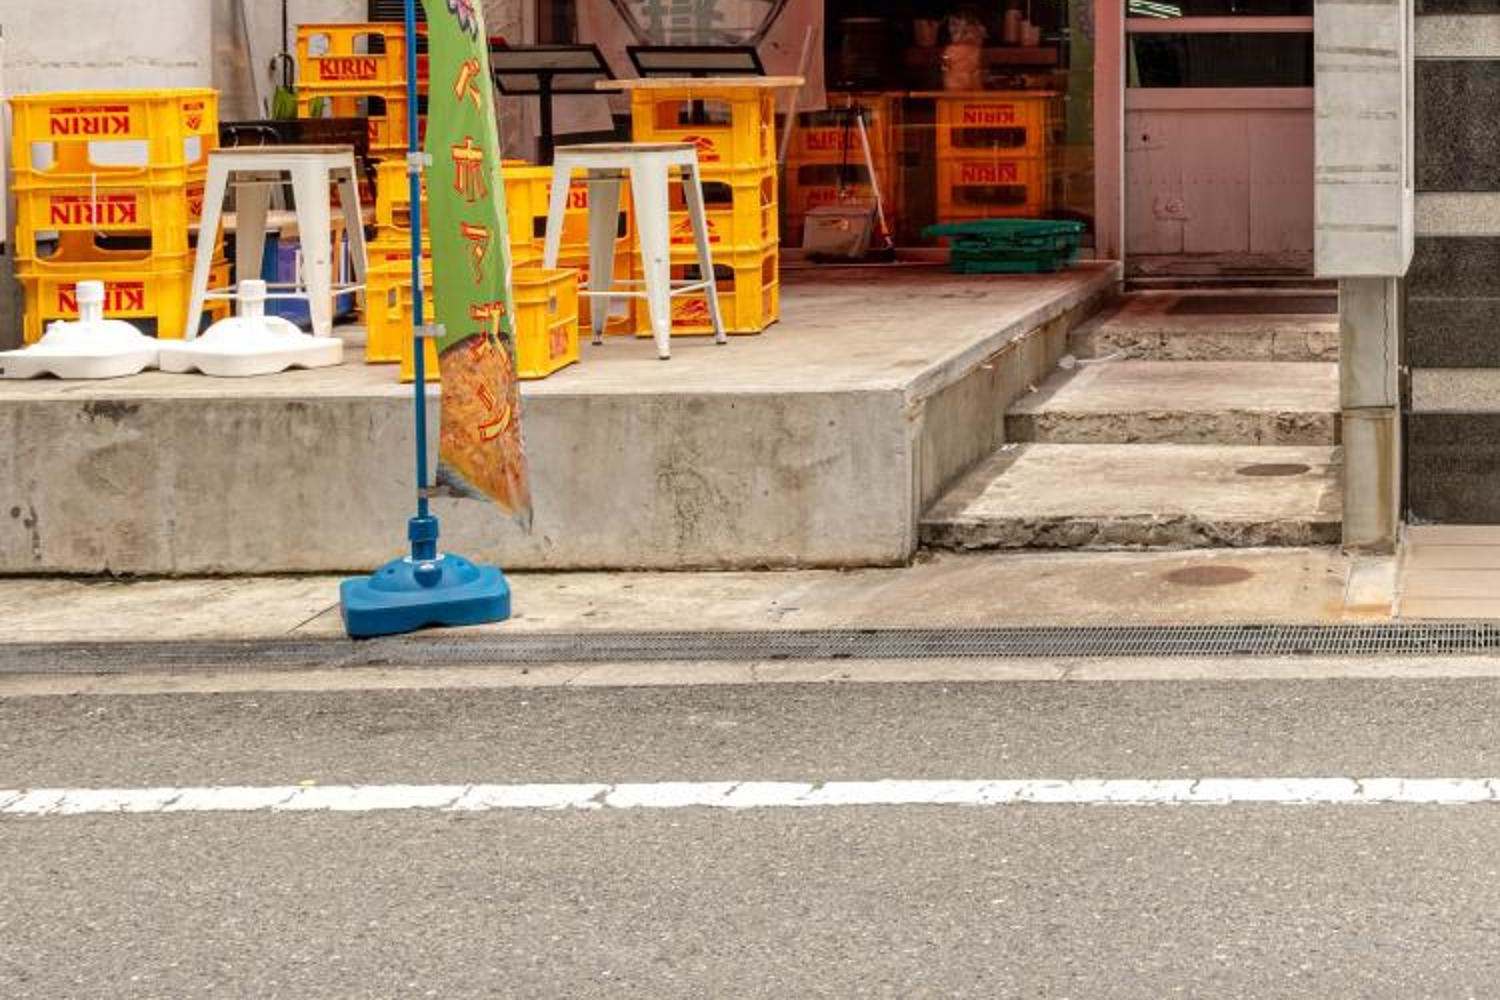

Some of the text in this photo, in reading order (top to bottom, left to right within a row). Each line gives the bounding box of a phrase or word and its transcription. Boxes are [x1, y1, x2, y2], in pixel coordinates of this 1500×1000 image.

[320, 58, 377, 75] KIRIN
[50, 115, 130, 136] KIRIN
[50, 203, 137, 225] KIRIN
[58, 289, 144, 312] KIN
